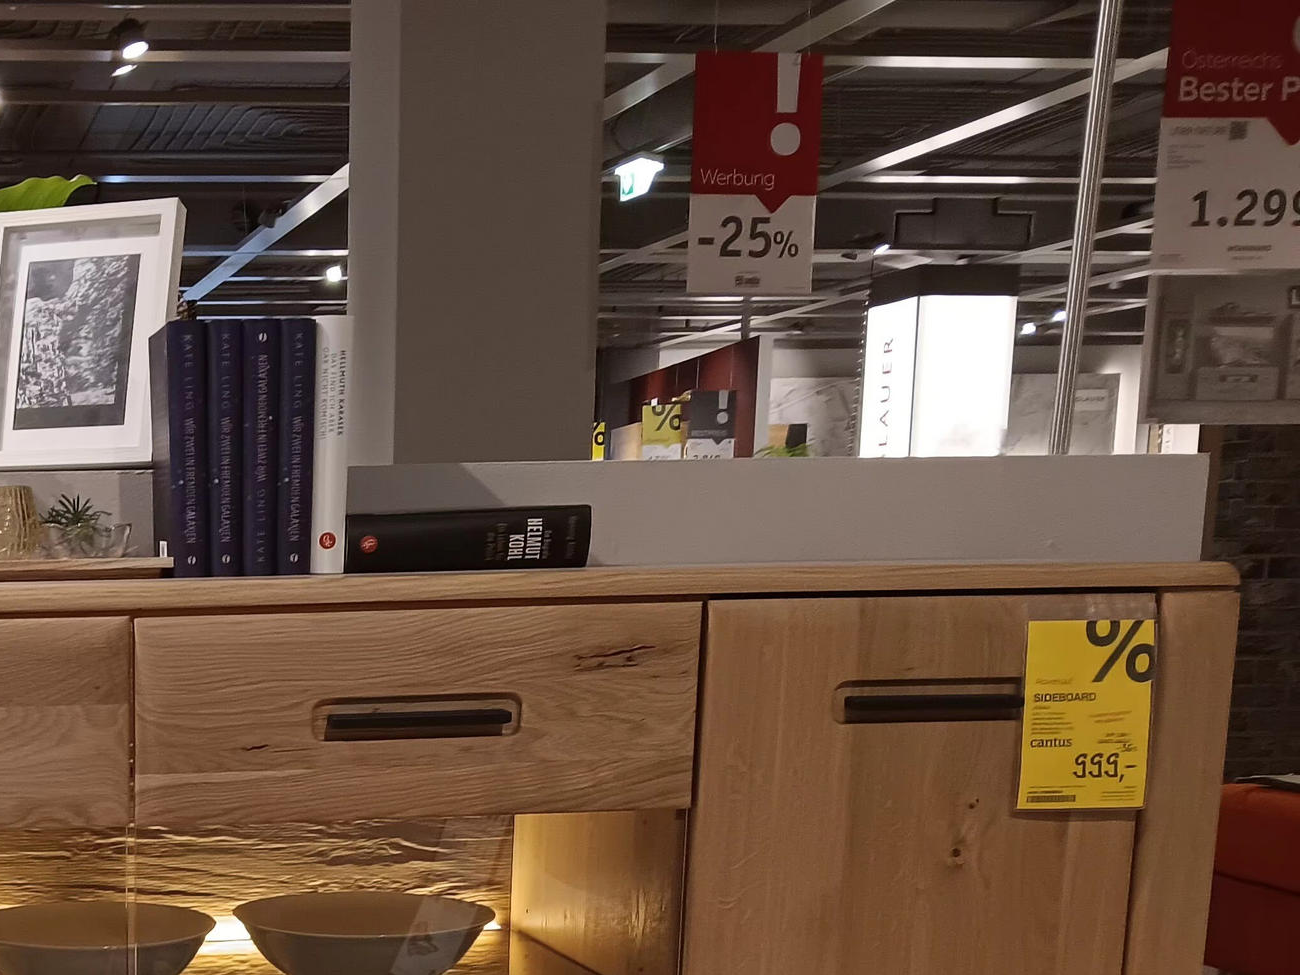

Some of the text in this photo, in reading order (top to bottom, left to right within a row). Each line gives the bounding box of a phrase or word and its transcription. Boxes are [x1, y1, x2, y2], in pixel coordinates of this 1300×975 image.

[1179, 75, 1274, 102] Bester
[699, 168, 775, 191] Werbung
[698, 215, 799, 259] -25%
[182, 334, 194, 367] KATE
[221, 333, 231, 367] KATE
[295, 333, 304, 366] KATE
[184, 377, 194, 410] LING
[222, 376, 231, 410] LING
[337, 350, 347, 436] HELLMUTH KARASEK
[878, 338, 894, 457] LAUER
[256, 488, 266, 521] LING
[257, 530, 267, 562] KATE
[507, 534, 525, 561] KOHL
[524, 517, 543, 560] HELMUT
[1033, 692, 1096, 703] SIDEBOARD
[1029, 738, 1072, 749] cantus
